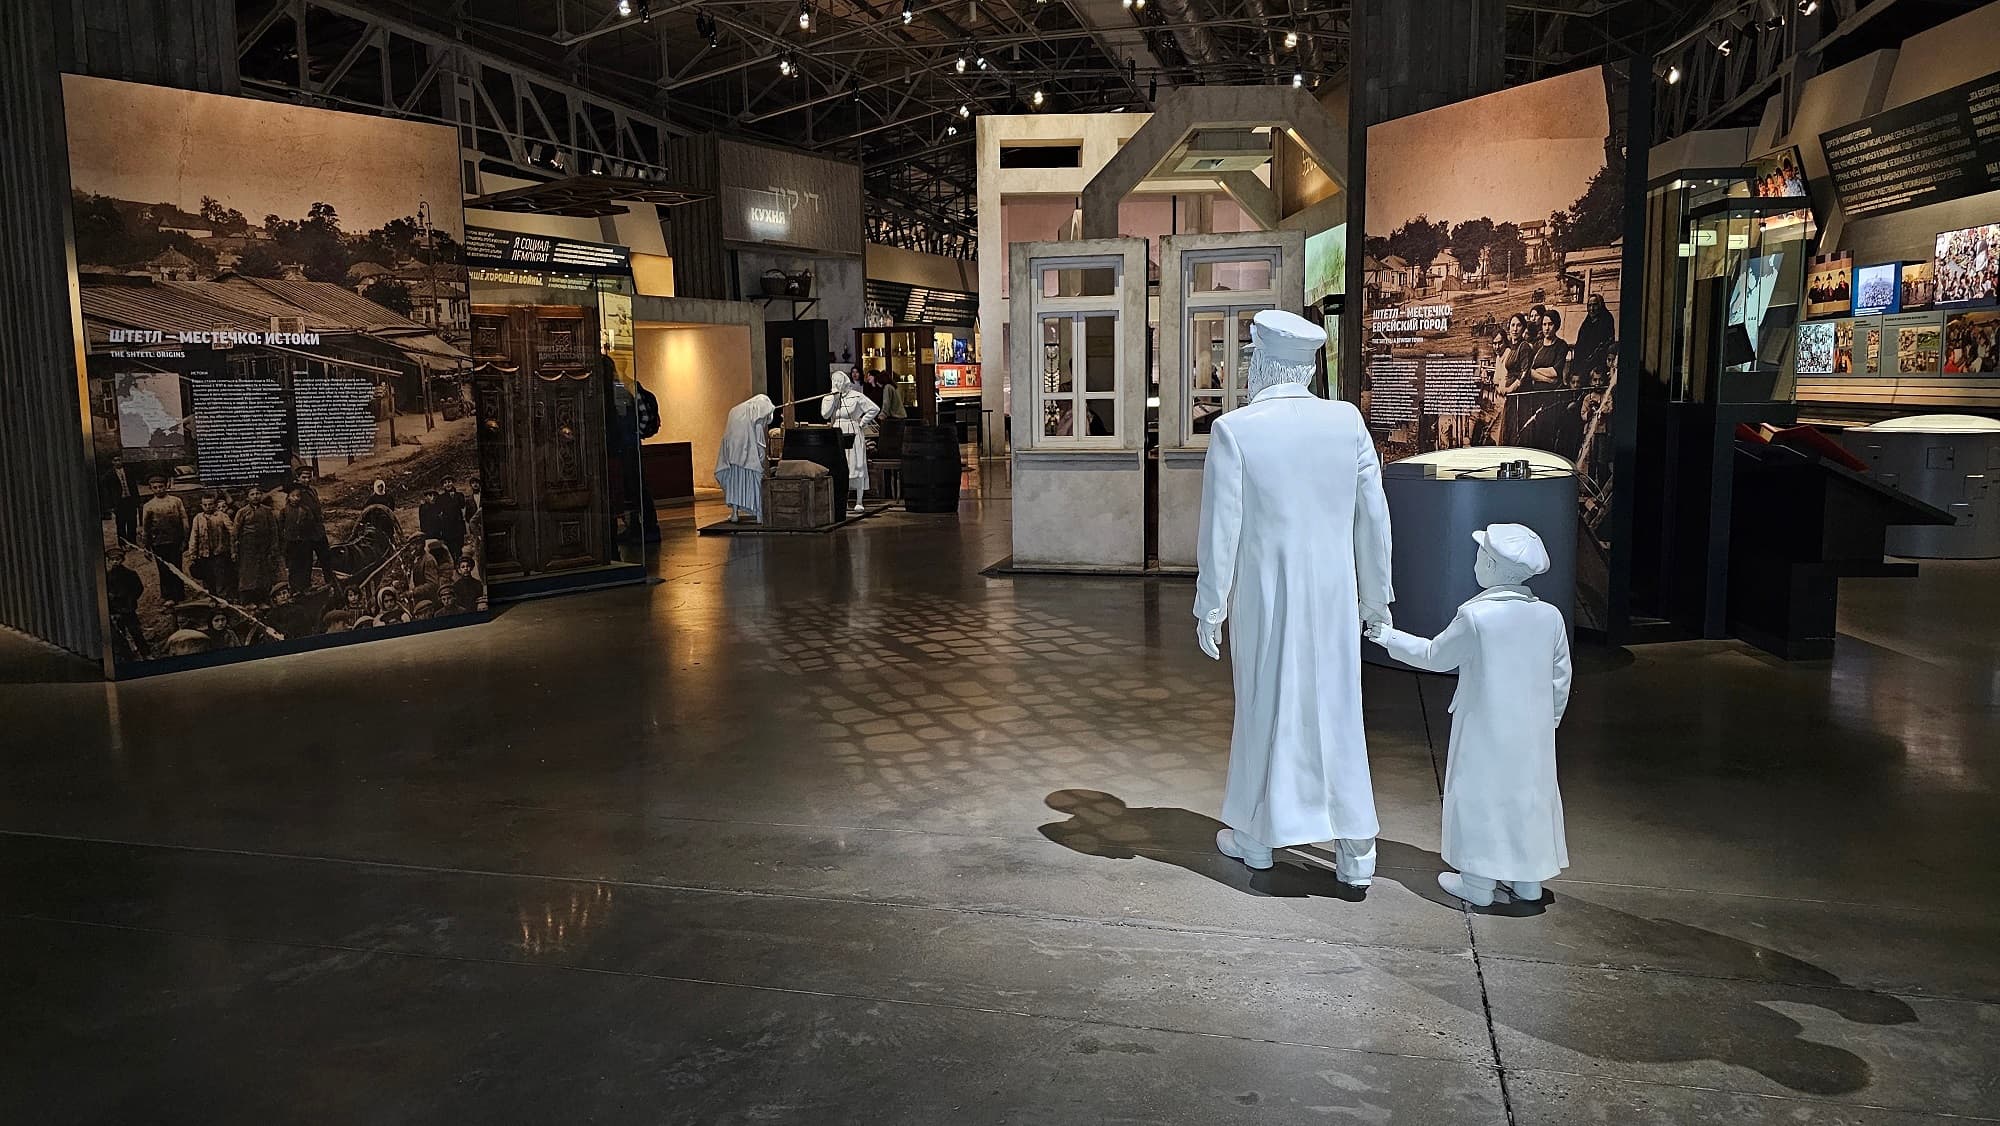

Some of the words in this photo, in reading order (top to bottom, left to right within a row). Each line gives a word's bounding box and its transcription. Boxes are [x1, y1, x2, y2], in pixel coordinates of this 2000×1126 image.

[751, 207, 785, 224] КУХНЯ
[513, 237, 520, 249] Я
[521, 237, 551, 253] СОЦИАЛ-
[511, 250, 549, 263] ДЕМОКРАТ
[1373, 308, 1399, 320] ШТЕТЛ
[1407, 305, 1453, 318] МЕСТЕЧКО:
[1373, 318, 1418, 332] ЕВРЕЙСКИЙ
[1420, 318, 1448, 332] ГОРОД
[109, 330, 162, 343] ШТЕТЛ
[179, 331, 262, 345] МЕСТЕЧКО:
[265, 332, 320, 345] ИСТОКИ
